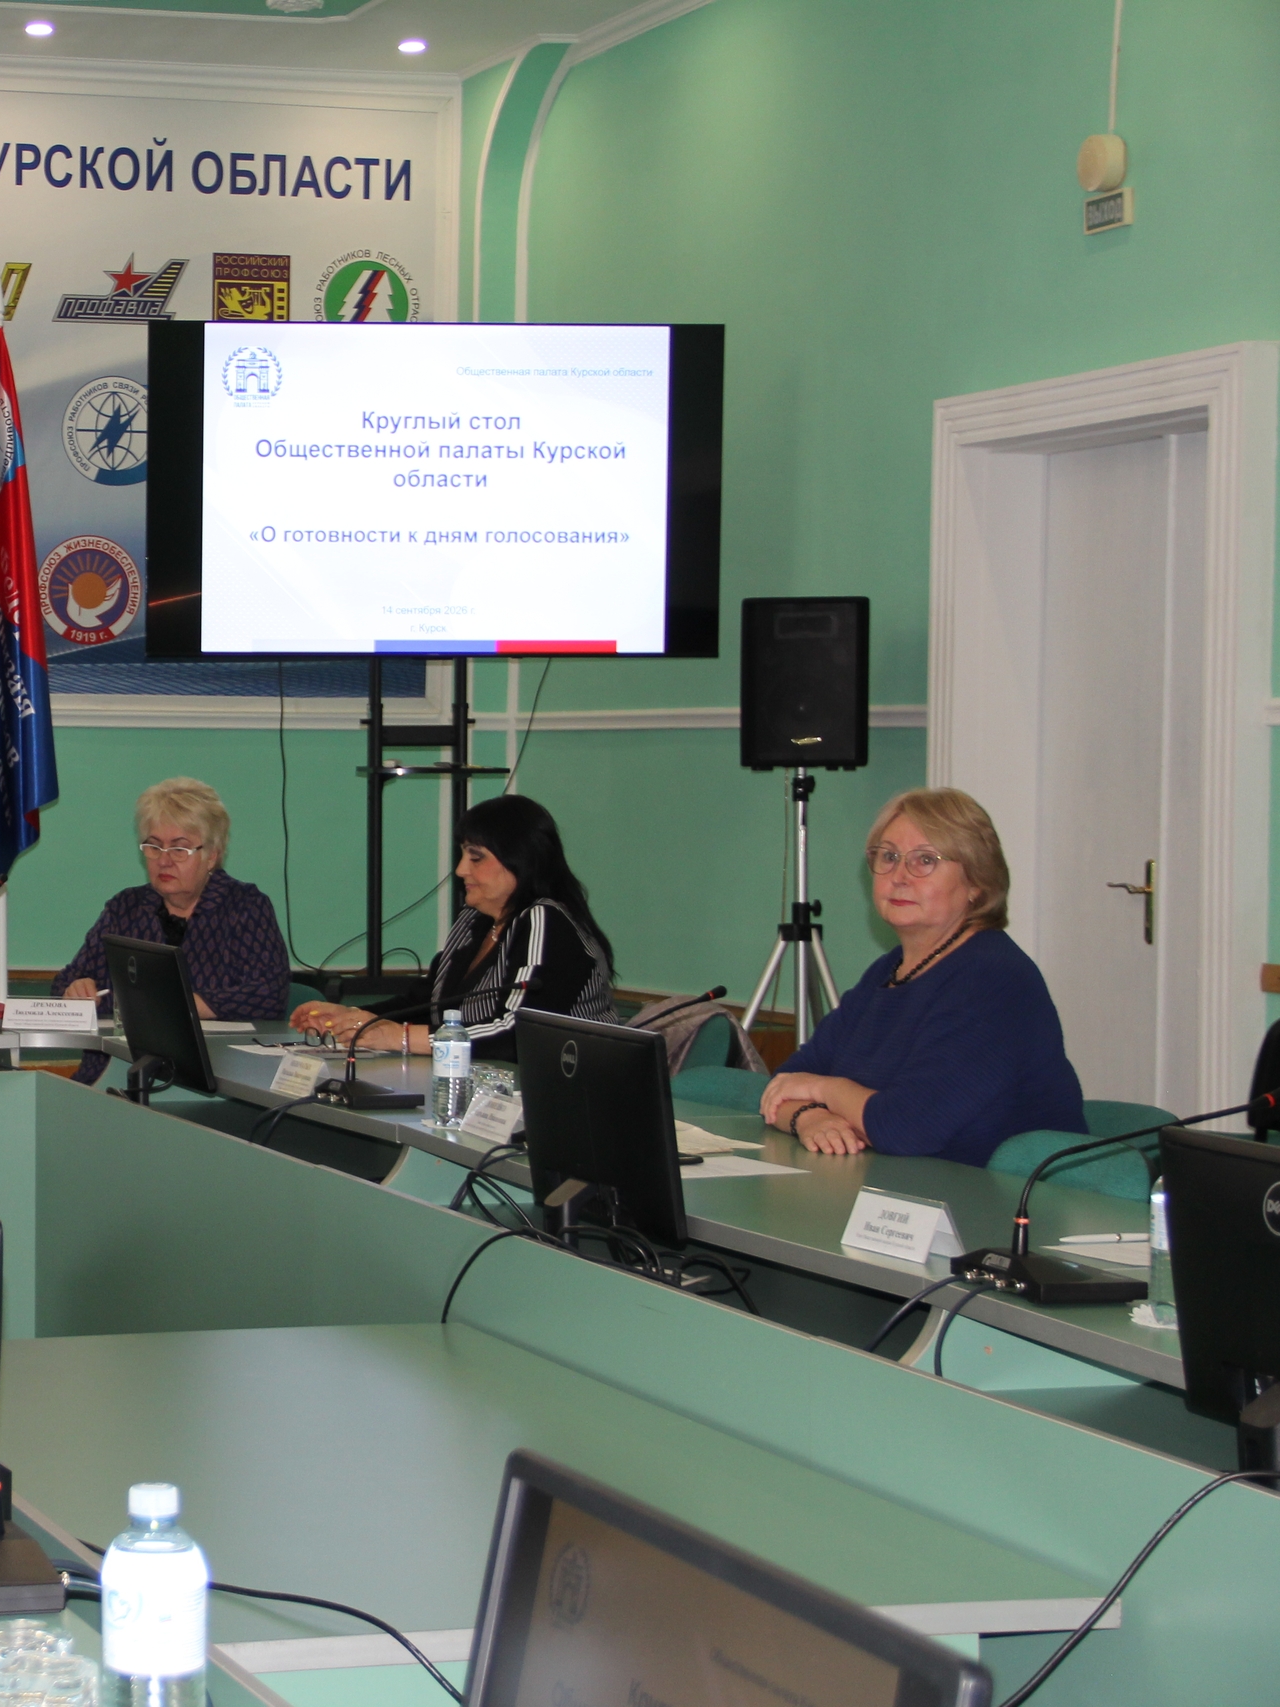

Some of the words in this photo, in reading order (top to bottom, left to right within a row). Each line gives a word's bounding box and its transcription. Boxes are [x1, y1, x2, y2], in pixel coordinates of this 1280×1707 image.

[191, 150, 411, 201] ОБЛАСТИ
[216, 255, 289, 267] РОССИЙСКИЙ
[215, 268, 289, 279] ПРОФСОЮЗ
[315, 249, 371, 292] РАБОТНИКОВ
[375, 251, 414, 284] ЛЕСНЫХ
[409, 287, 420, 322] ОТРАС
[456, 366, 530, 377] Общественная
[533, 368, 567, 377] палата
[571, 367, 609, 378] Курской
[613, 368, 653, 377] области
[112, 381, 140, 396] СВЯЗИ
[68, 382, 109, 421] РАБОТНИКОВ
[362, 410, 461, 436] Круглый
[469, 415, 521, 431] стол
[67, 426, 90, 472] ПРОФСОЮЗ
[255, 439, 430, 463] Общественной
[439, 443, 525, 460] палаты
[533, 440, 626, 466] Курской
[393, 468, 488, 488] области
[249, 526, 277, 544] «О
[284, 528, 402, 544] готовности
[408, 529, 418, 544] к
[424, 529, 478, 547] дням
[486, 529, 630, 546] голосования»
[39, 551, 62, 616] ПРОФСОЮЗ
[64, 539, 141, 616] ЖИЗНЕОБЕСПЕЧЕНИЯ
[382, 605, 392, 615] 14
[395, 605, 441, 616] сентября
[70, 629, 96, 642] 1919
[99, 632, 108, 640] г.
[418, 623, 447, 634] Курск
[877, 1208, 910, 1225] ДОВГИЙ
[863, 1221, 880, 1233] Иван
[880, 1225, 915, 1242] Сергеевич
